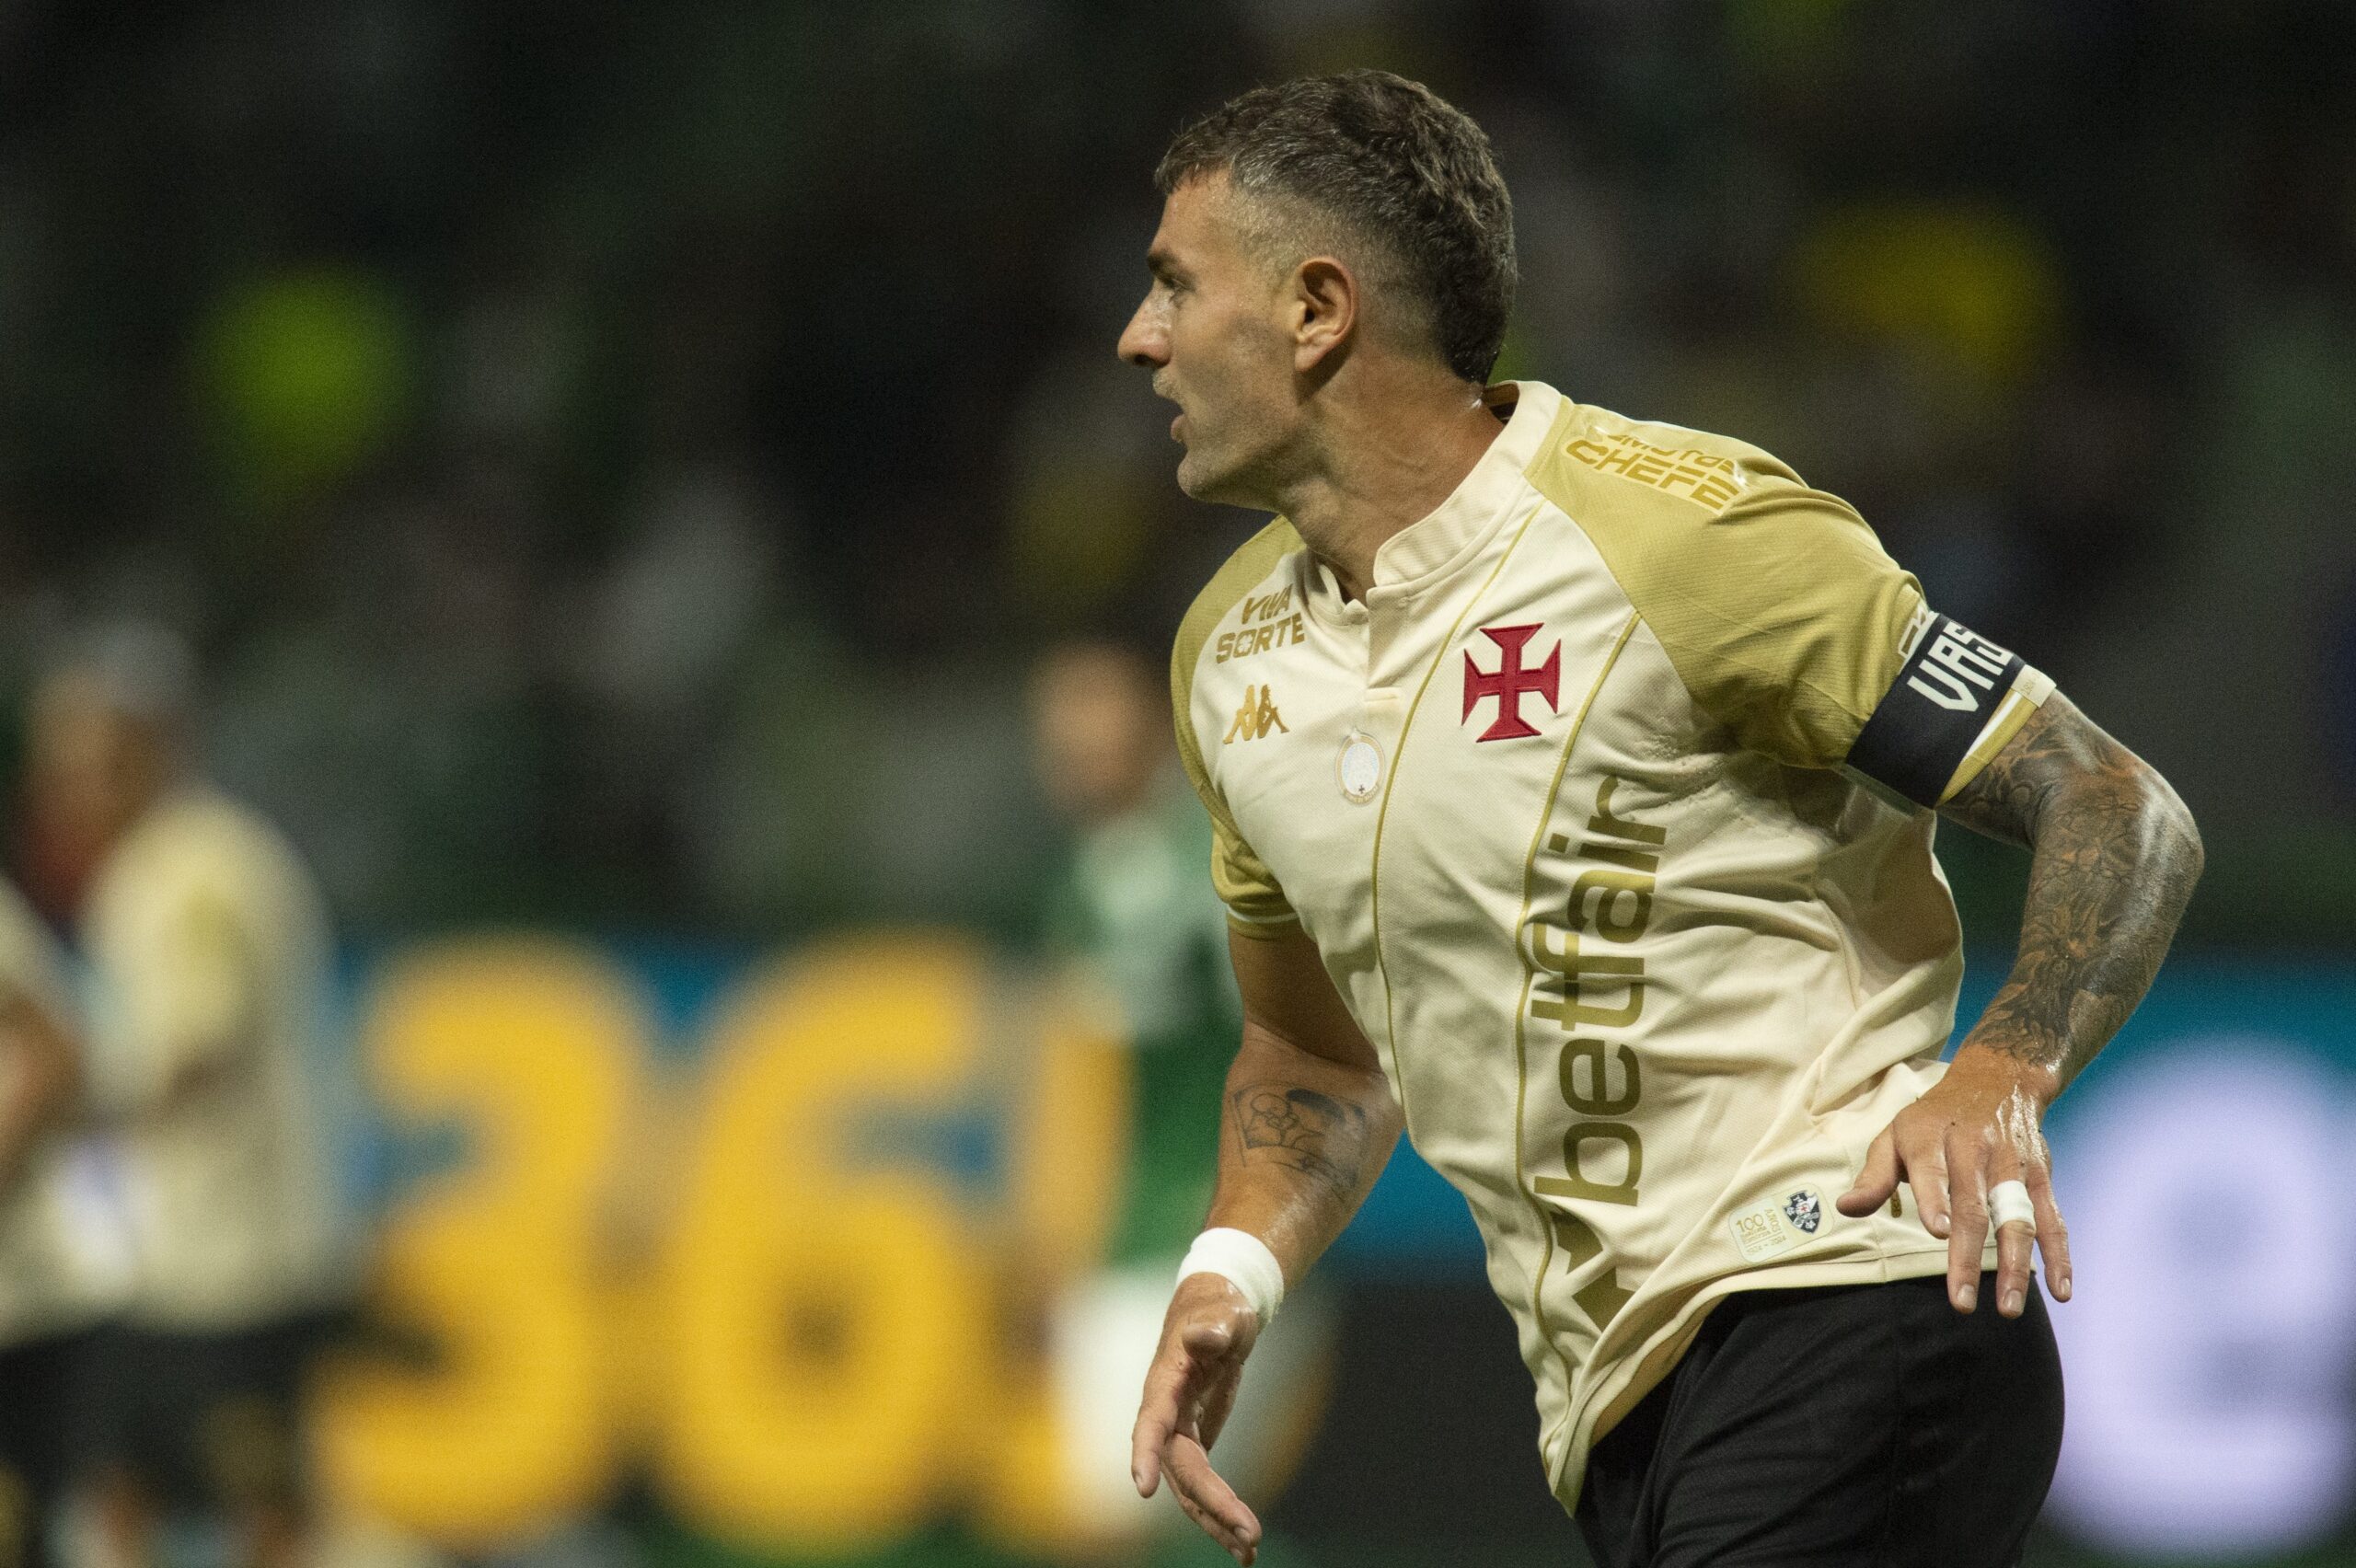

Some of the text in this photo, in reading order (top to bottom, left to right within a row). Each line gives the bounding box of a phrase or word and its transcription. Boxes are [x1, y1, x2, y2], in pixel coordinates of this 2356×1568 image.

[1565, 439, 1739, 511] CHEFE
[1216, 612, 1305, 664] SORTE
[1530, 775, 1668, 1207] betfair
